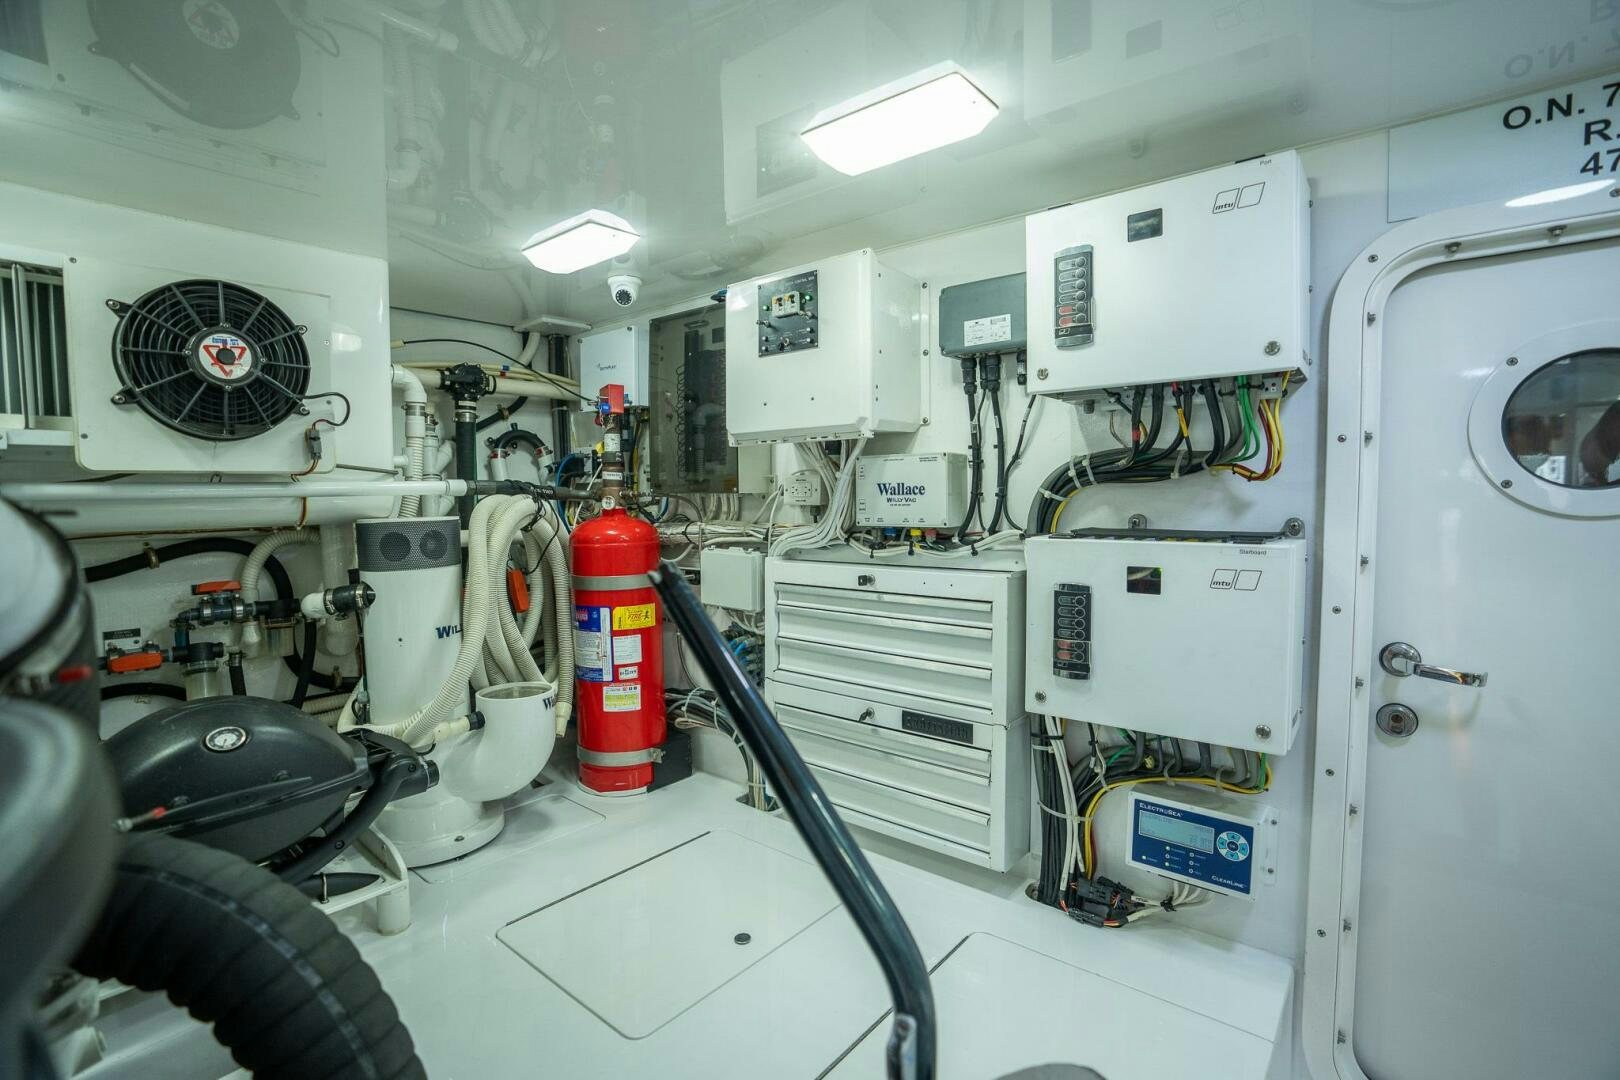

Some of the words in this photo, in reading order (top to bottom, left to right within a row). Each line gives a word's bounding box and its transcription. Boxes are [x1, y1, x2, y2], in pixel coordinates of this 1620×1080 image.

[1503, 94, 1585, 130] O.N.
[1215, 202, 1234, 211] mtu
[877, 482, 926, 496] Wallace
